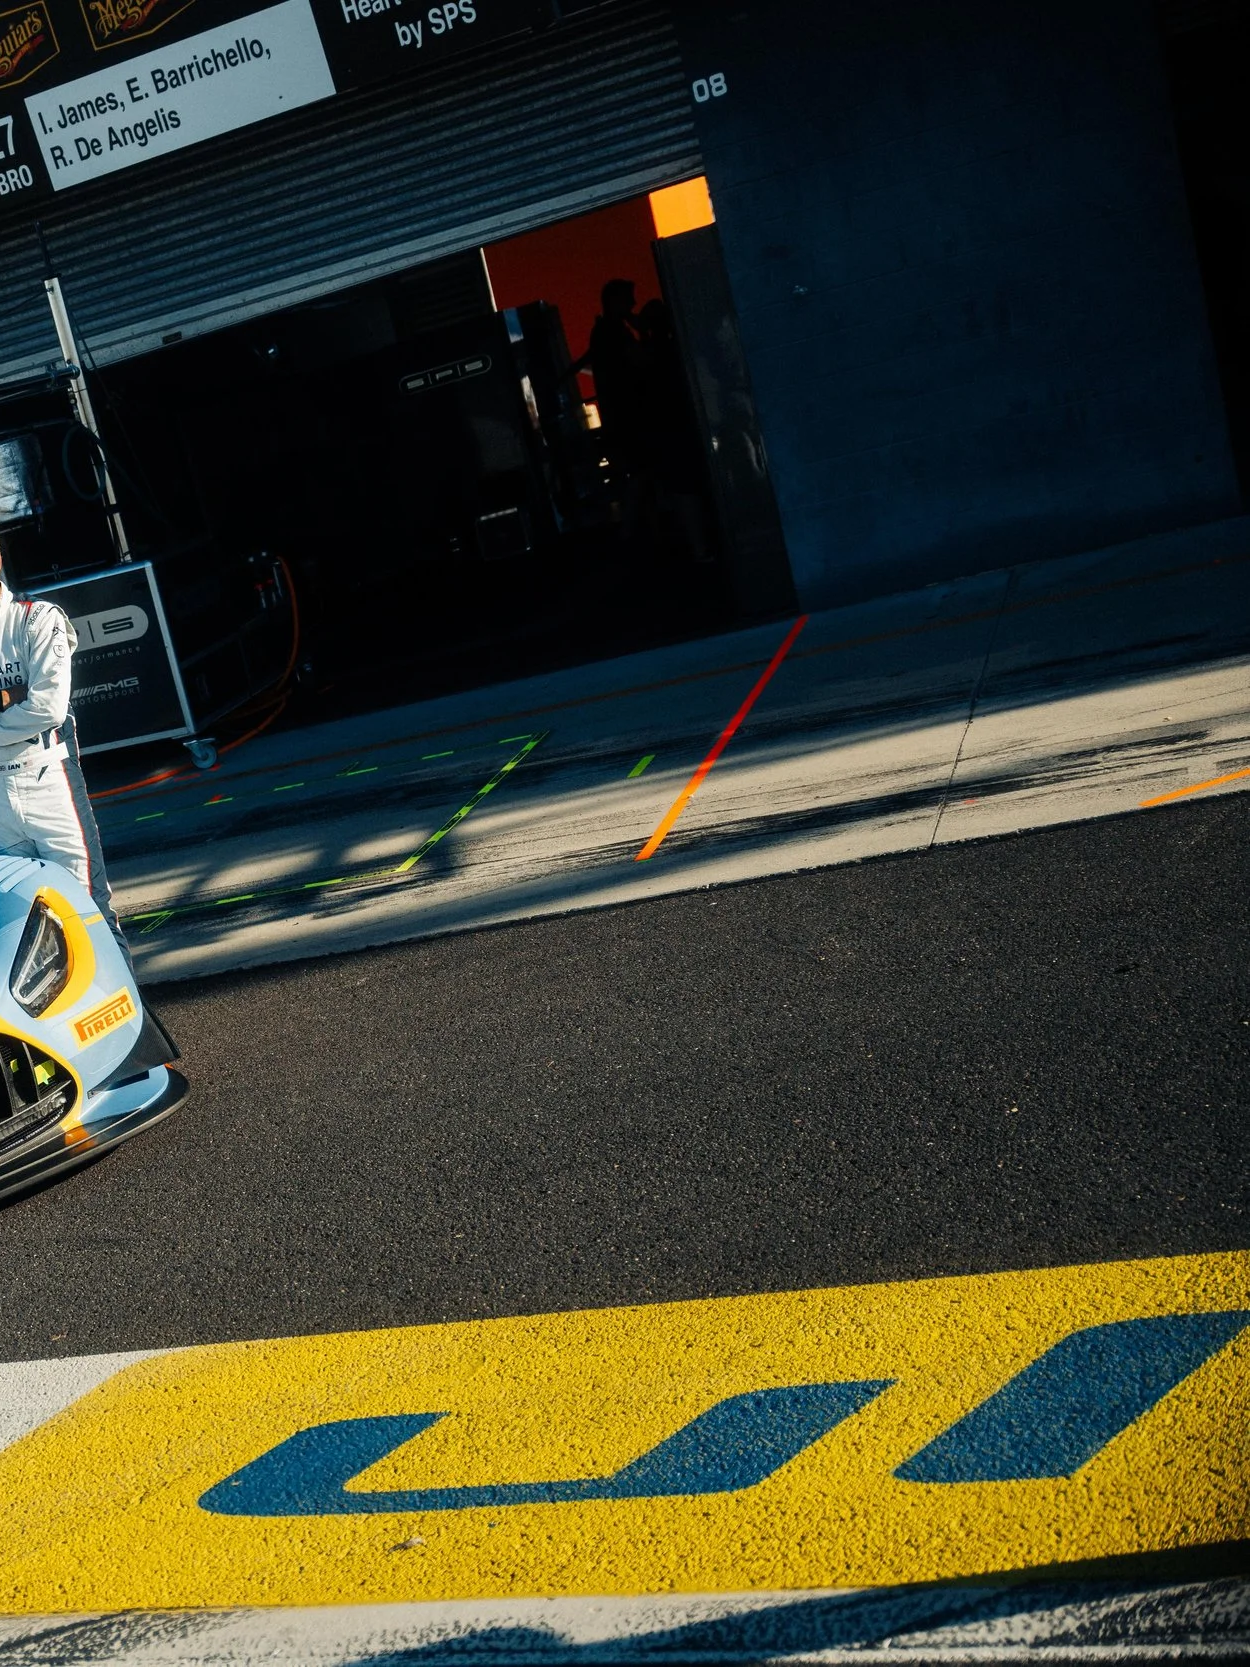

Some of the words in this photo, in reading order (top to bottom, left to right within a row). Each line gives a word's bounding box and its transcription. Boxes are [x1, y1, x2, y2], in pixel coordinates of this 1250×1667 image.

[340, 0, 401, 23] Hear
[395, 20, 422, 48] by
[427, 0, 477, 35] SPS
[38, 112, 53, 135] I.
[57, 92, 126, 129] James,
[126, 77, 150, 103] E.
[151, 37, 271, 95] Barrichello,
[693, 72, 728, 103] 08
[52, 146, 74, 169] R.
[74, 136, 103, 162] De
[108, 107, 181, 152] Angelis
[7, 763, 21, 771] IAN
[73, 994, 133, 1042] PIRELLI
